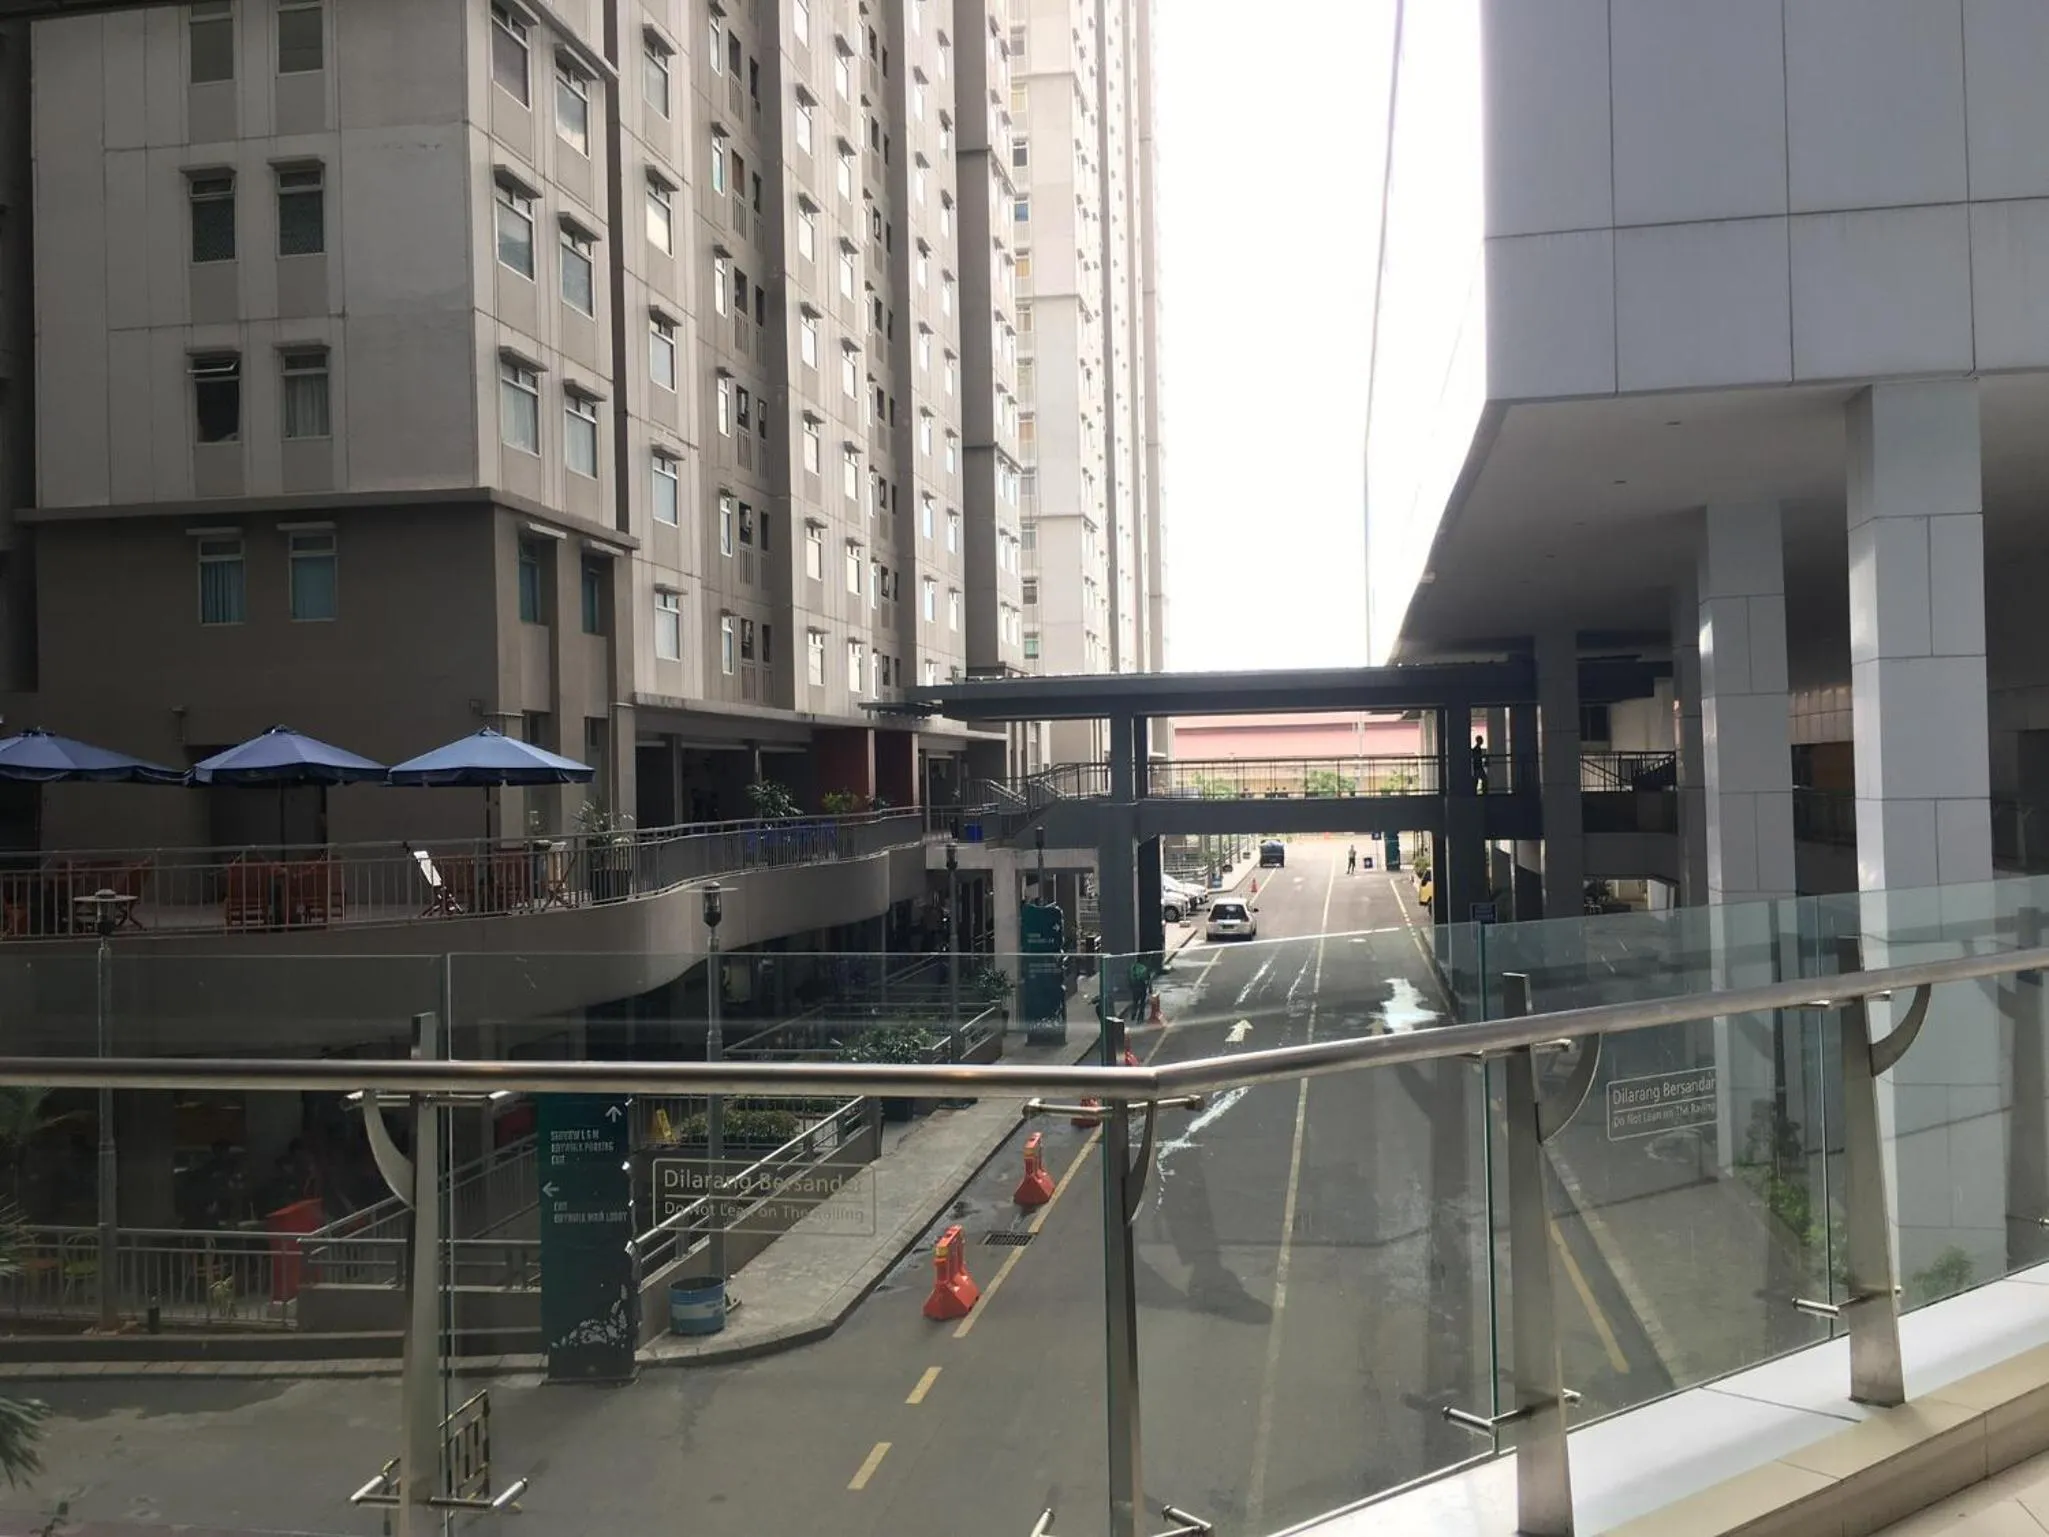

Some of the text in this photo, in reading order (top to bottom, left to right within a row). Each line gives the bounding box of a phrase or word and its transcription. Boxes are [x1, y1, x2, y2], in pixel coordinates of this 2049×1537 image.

[1613, 1076, 1717, 1105] Dilarang Bersandar
[664, 1169, 752, 1194] Dilarang
[664, 1201, 684, 1215] Do
[759, 1205, 777, 1218] on
